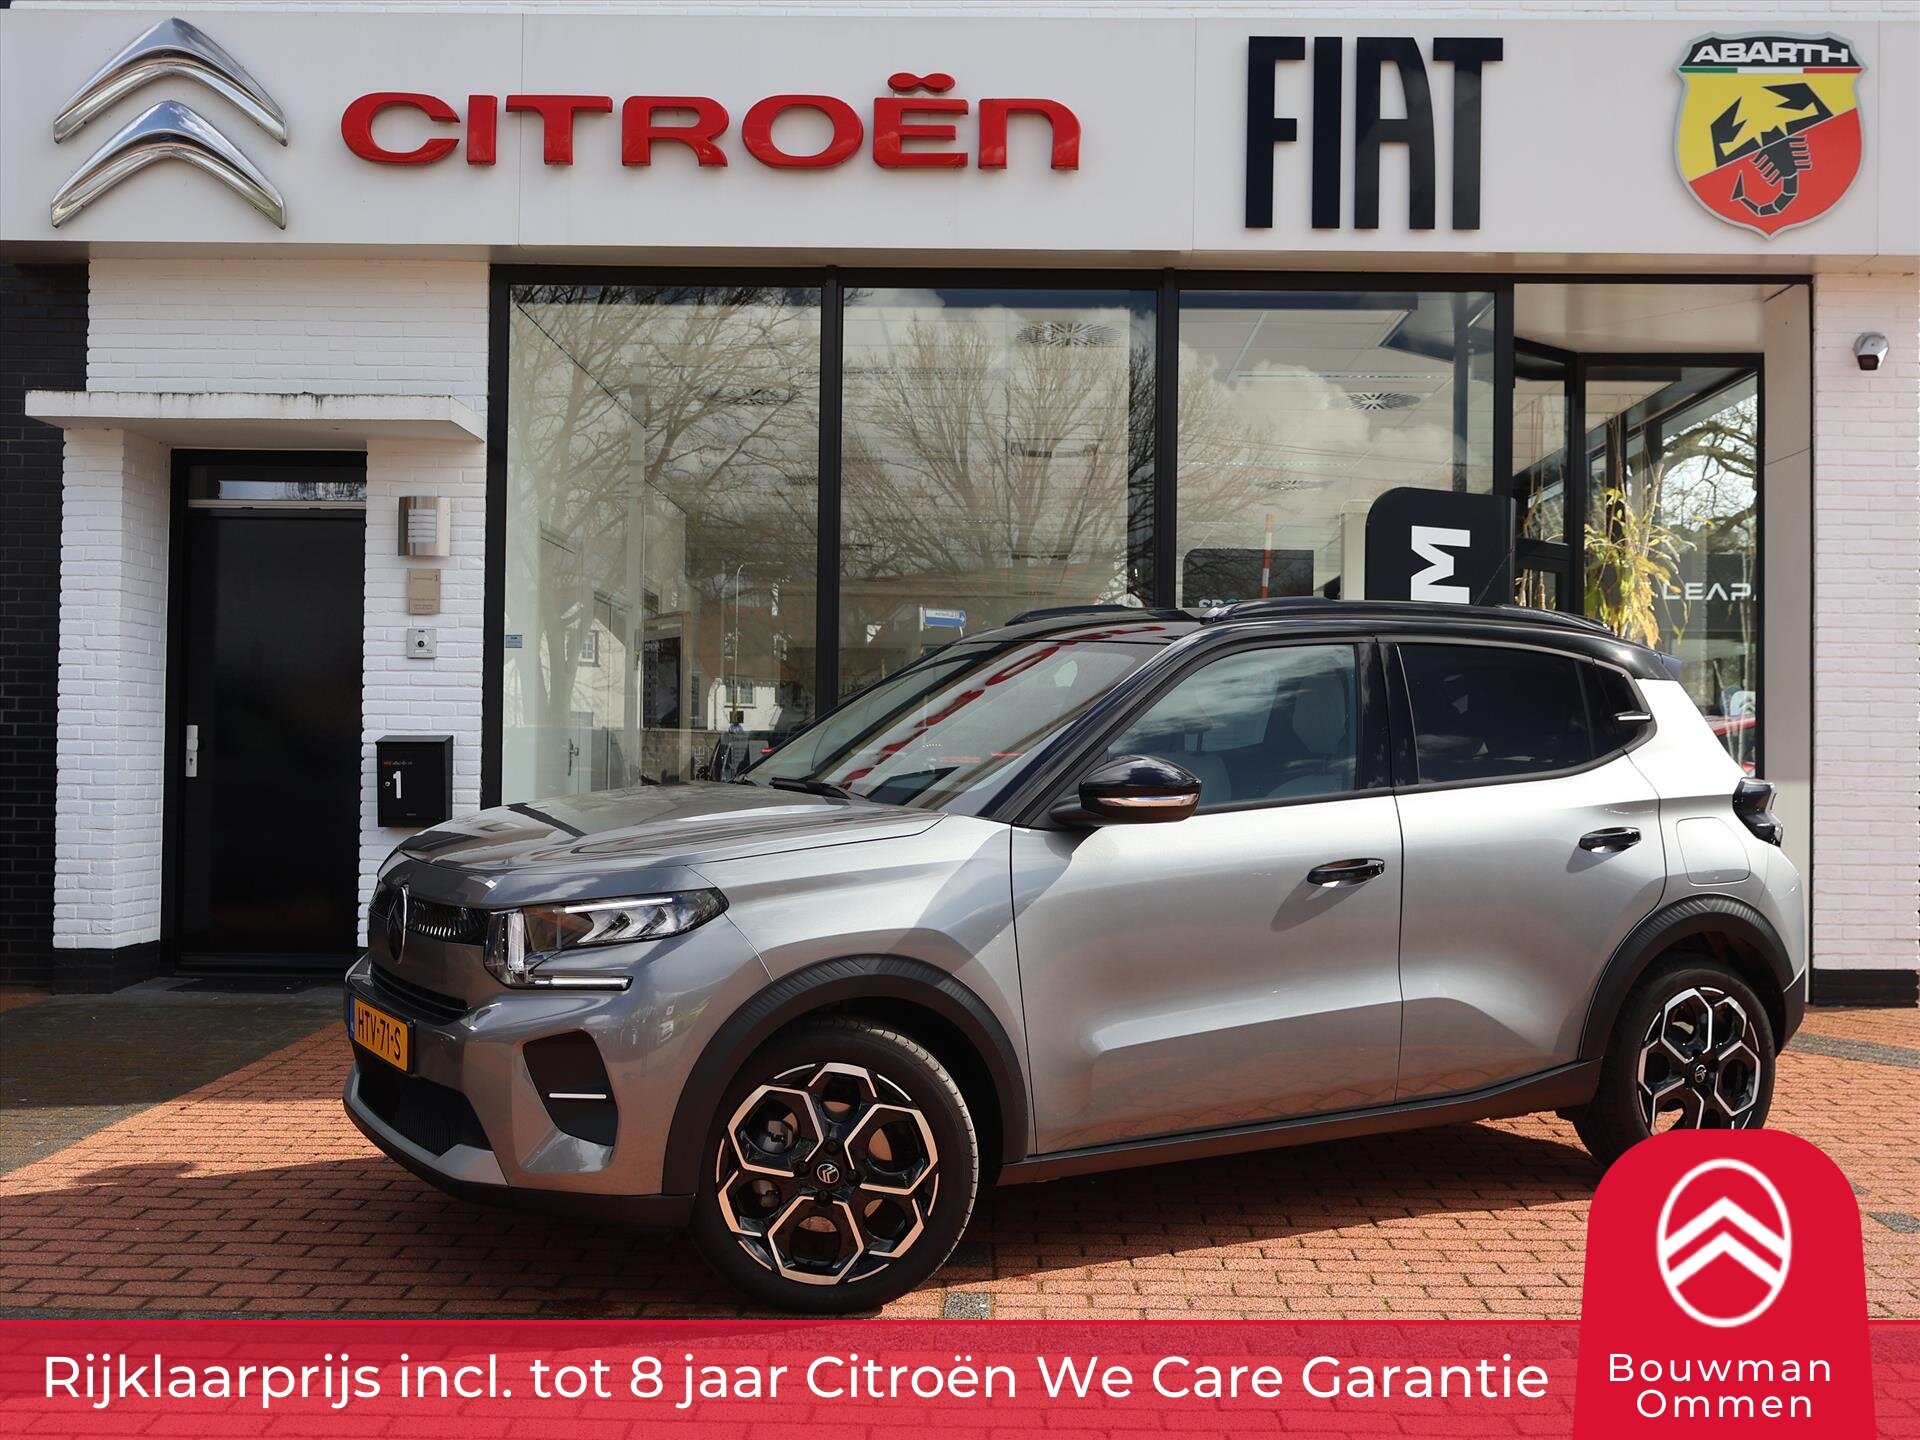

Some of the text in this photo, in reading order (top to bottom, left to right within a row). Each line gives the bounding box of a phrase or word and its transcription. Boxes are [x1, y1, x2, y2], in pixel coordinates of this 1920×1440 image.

[1692, 41, 1849, 63] ABARTH
[1245, 36, 1504, 230] FIAT
[1662, 582, 1757, 601] LEAP
[393, 770, 402, 799] 1
[358, 1006, 401, 1061] HTV-71-S
